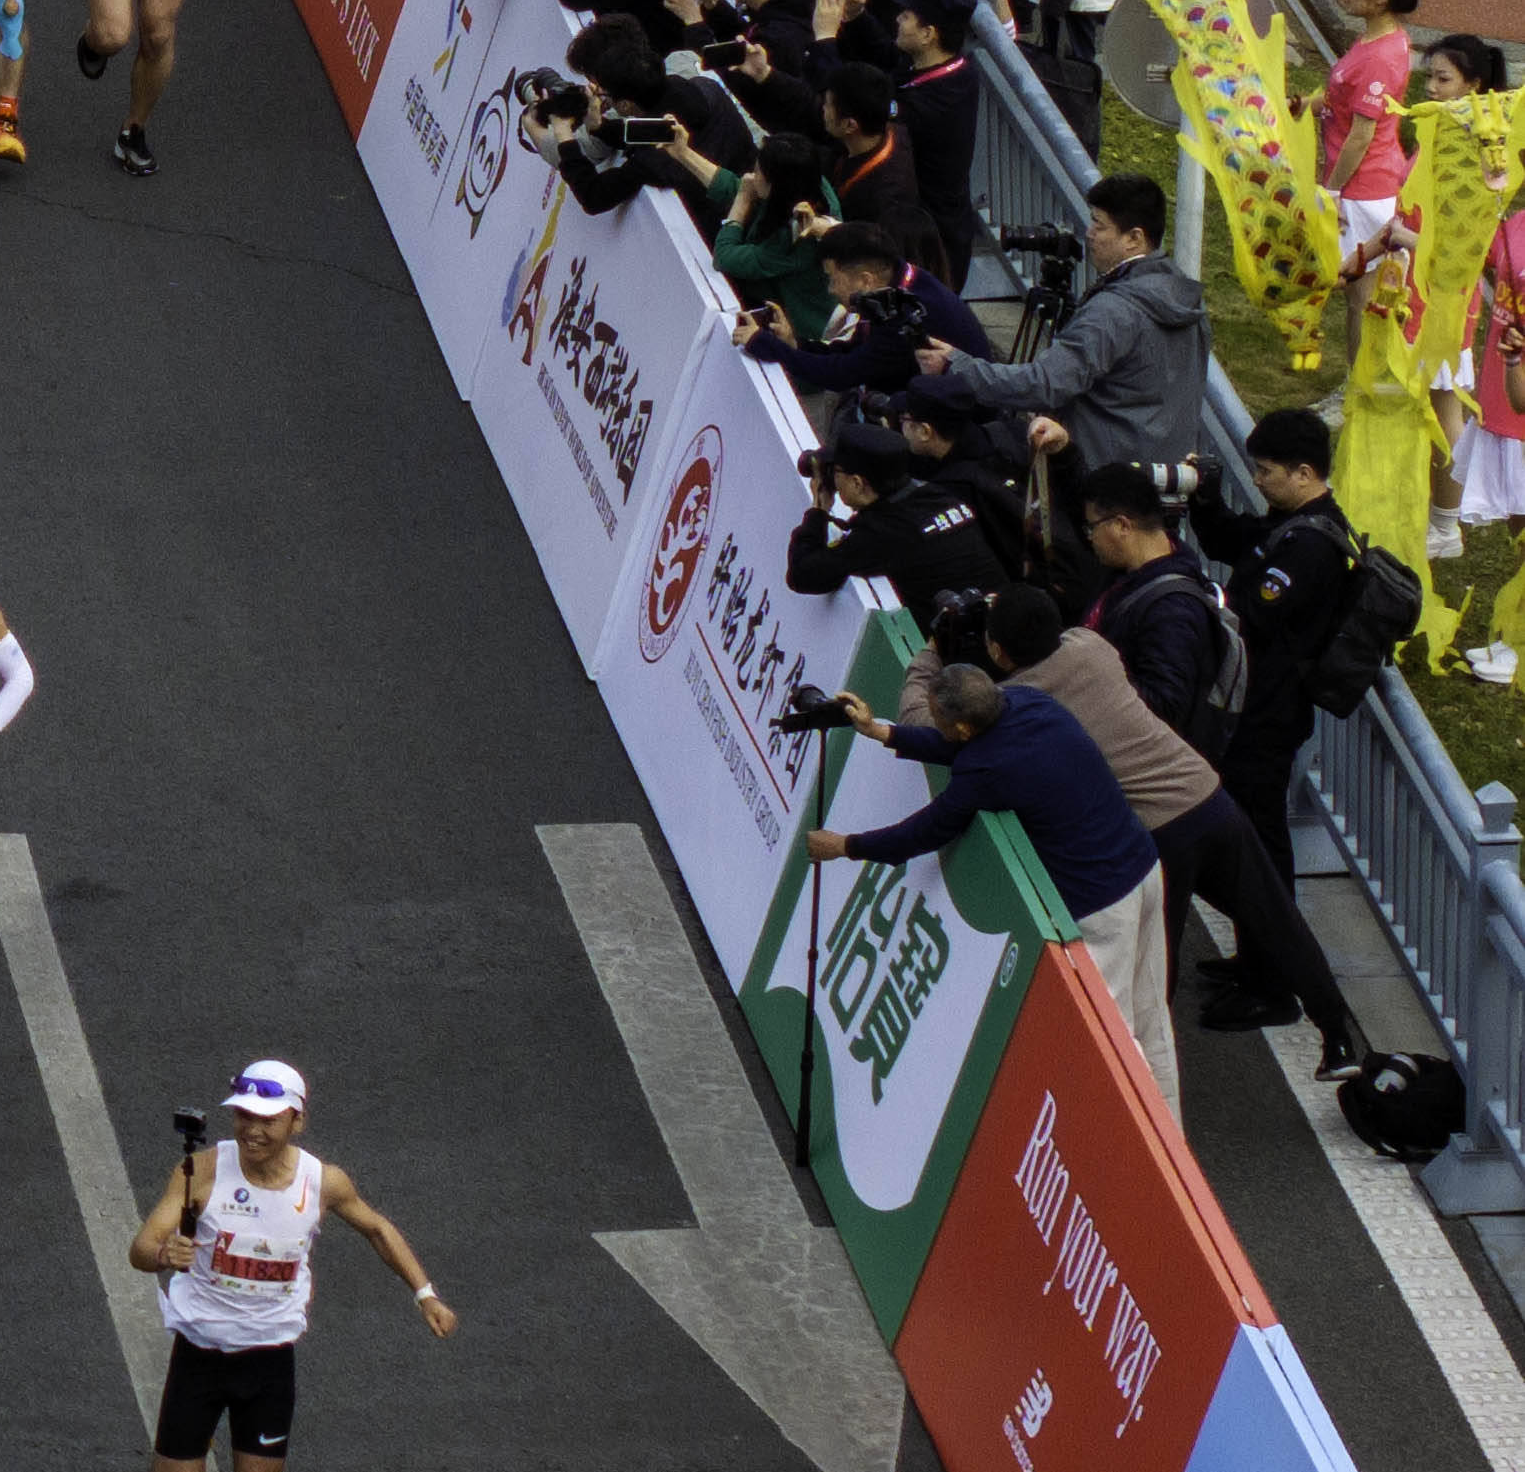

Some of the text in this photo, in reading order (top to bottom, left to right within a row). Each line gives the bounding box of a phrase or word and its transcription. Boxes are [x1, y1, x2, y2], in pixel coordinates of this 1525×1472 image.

[549, 256, 654, 507] 淮安西游乐园
[227, 1259, 295, 1282] 11820
[1014, 1089, 1163, 1439] Run your way.
